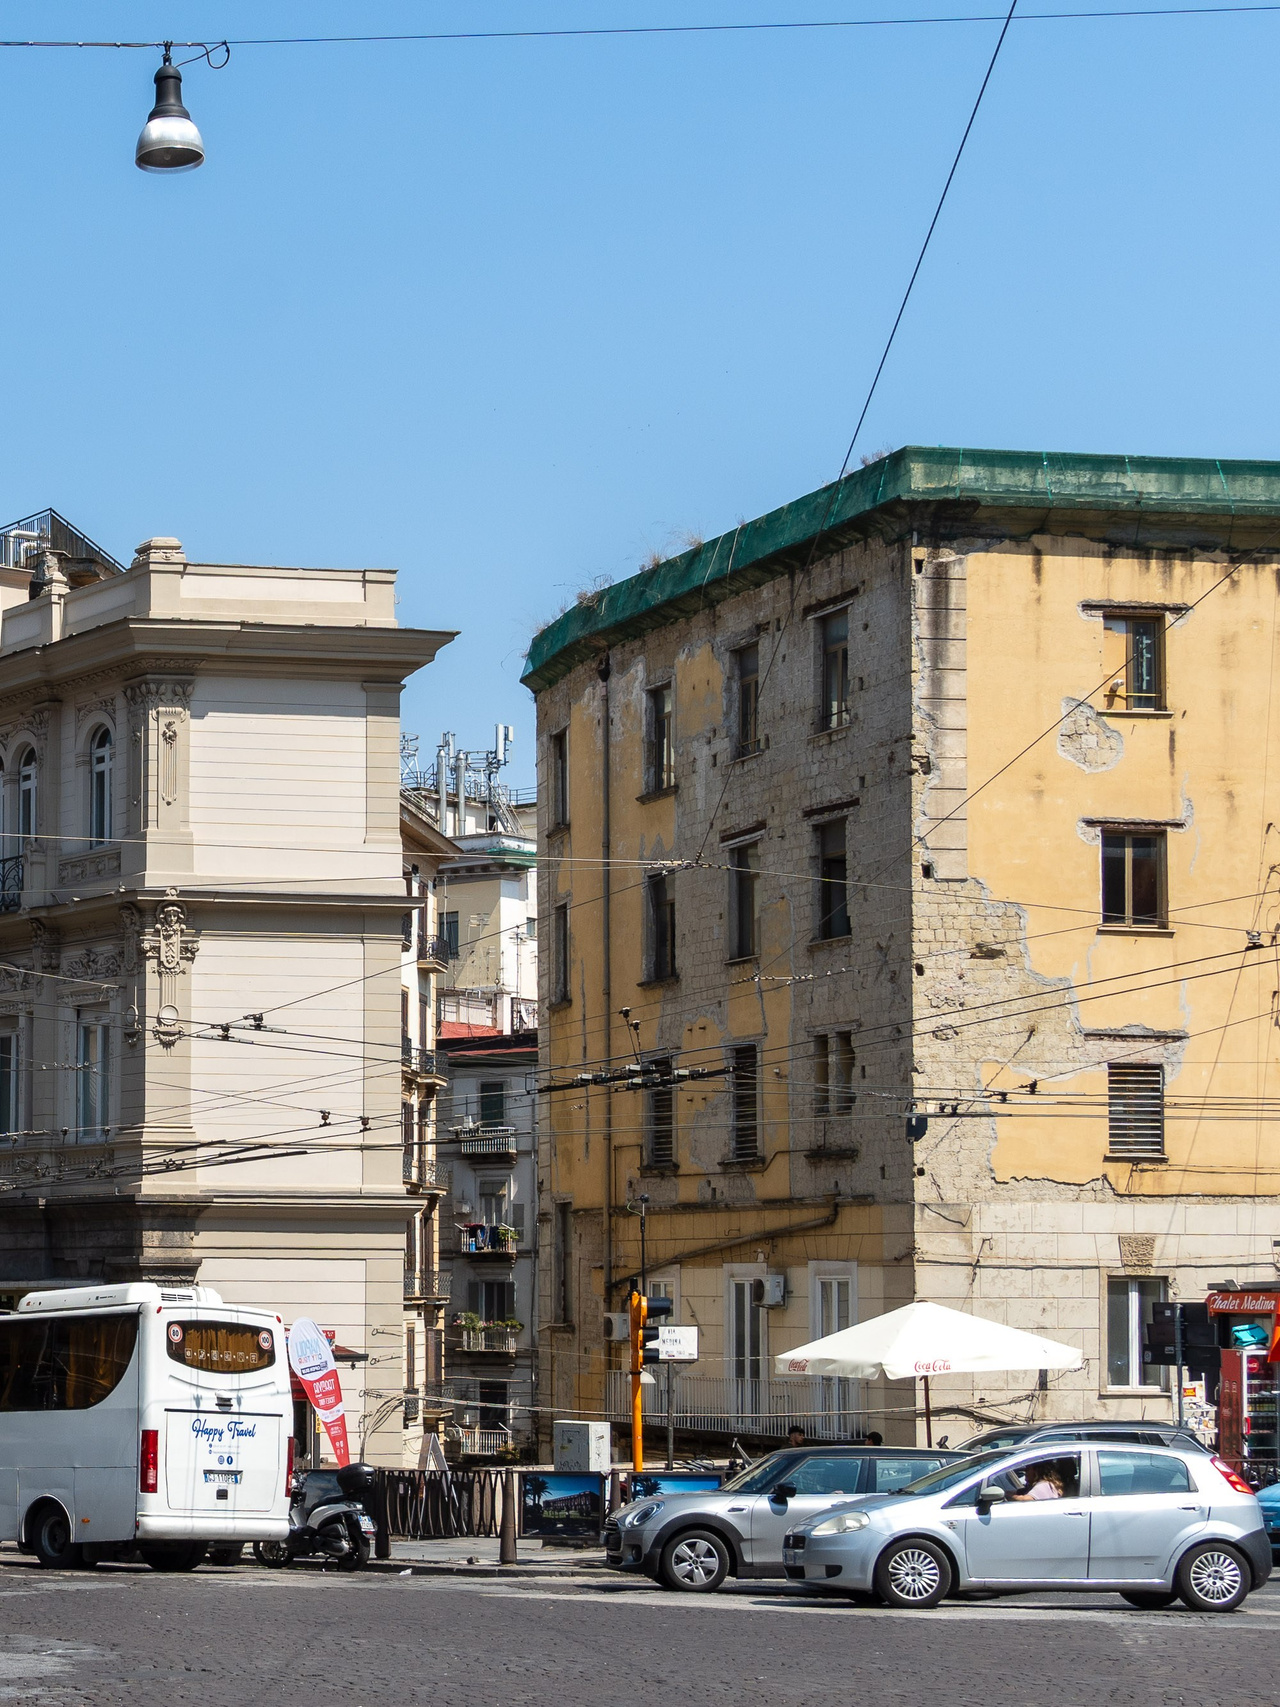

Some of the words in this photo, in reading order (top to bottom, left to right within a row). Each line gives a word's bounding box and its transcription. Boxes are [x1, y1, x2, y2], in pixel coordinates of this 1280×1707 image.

[1210, 1295, 1240, 1310] Chalet
[1241, 1296, 1276, 1310] Medina
[171, 1328, 180, 1337] 80
[261, 1335, 270, 1344] 100
[192, 1418, 224, 1441] Happy
[228, 1421, 256, 1440] Travel
